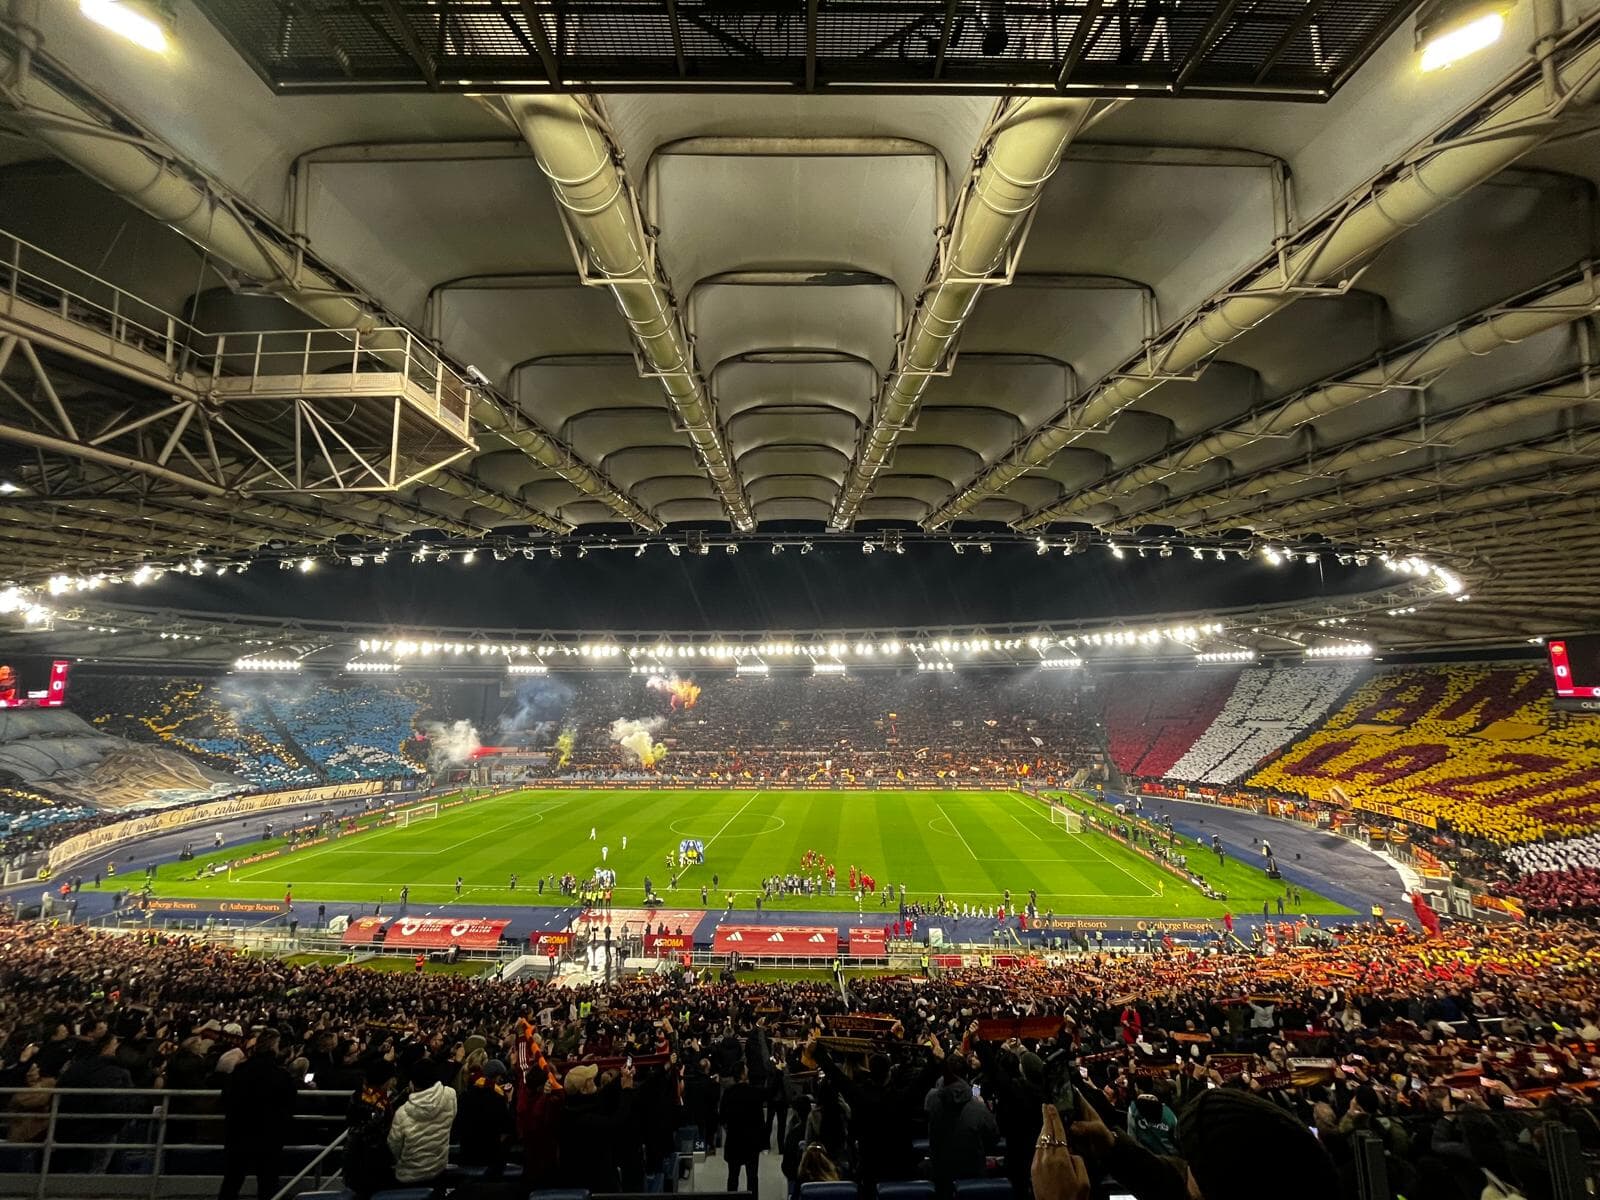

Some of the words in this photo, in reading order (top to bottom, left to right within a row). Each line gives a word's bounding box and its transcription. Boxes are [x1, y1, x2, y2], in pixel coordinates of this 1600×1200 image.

[1361, 799, 1394, 816] COME
[230, 903, 255, 912] Auberge
[255, 903, 280, 911] Resorts
[1077, 920, 1108, 928] Resorts
